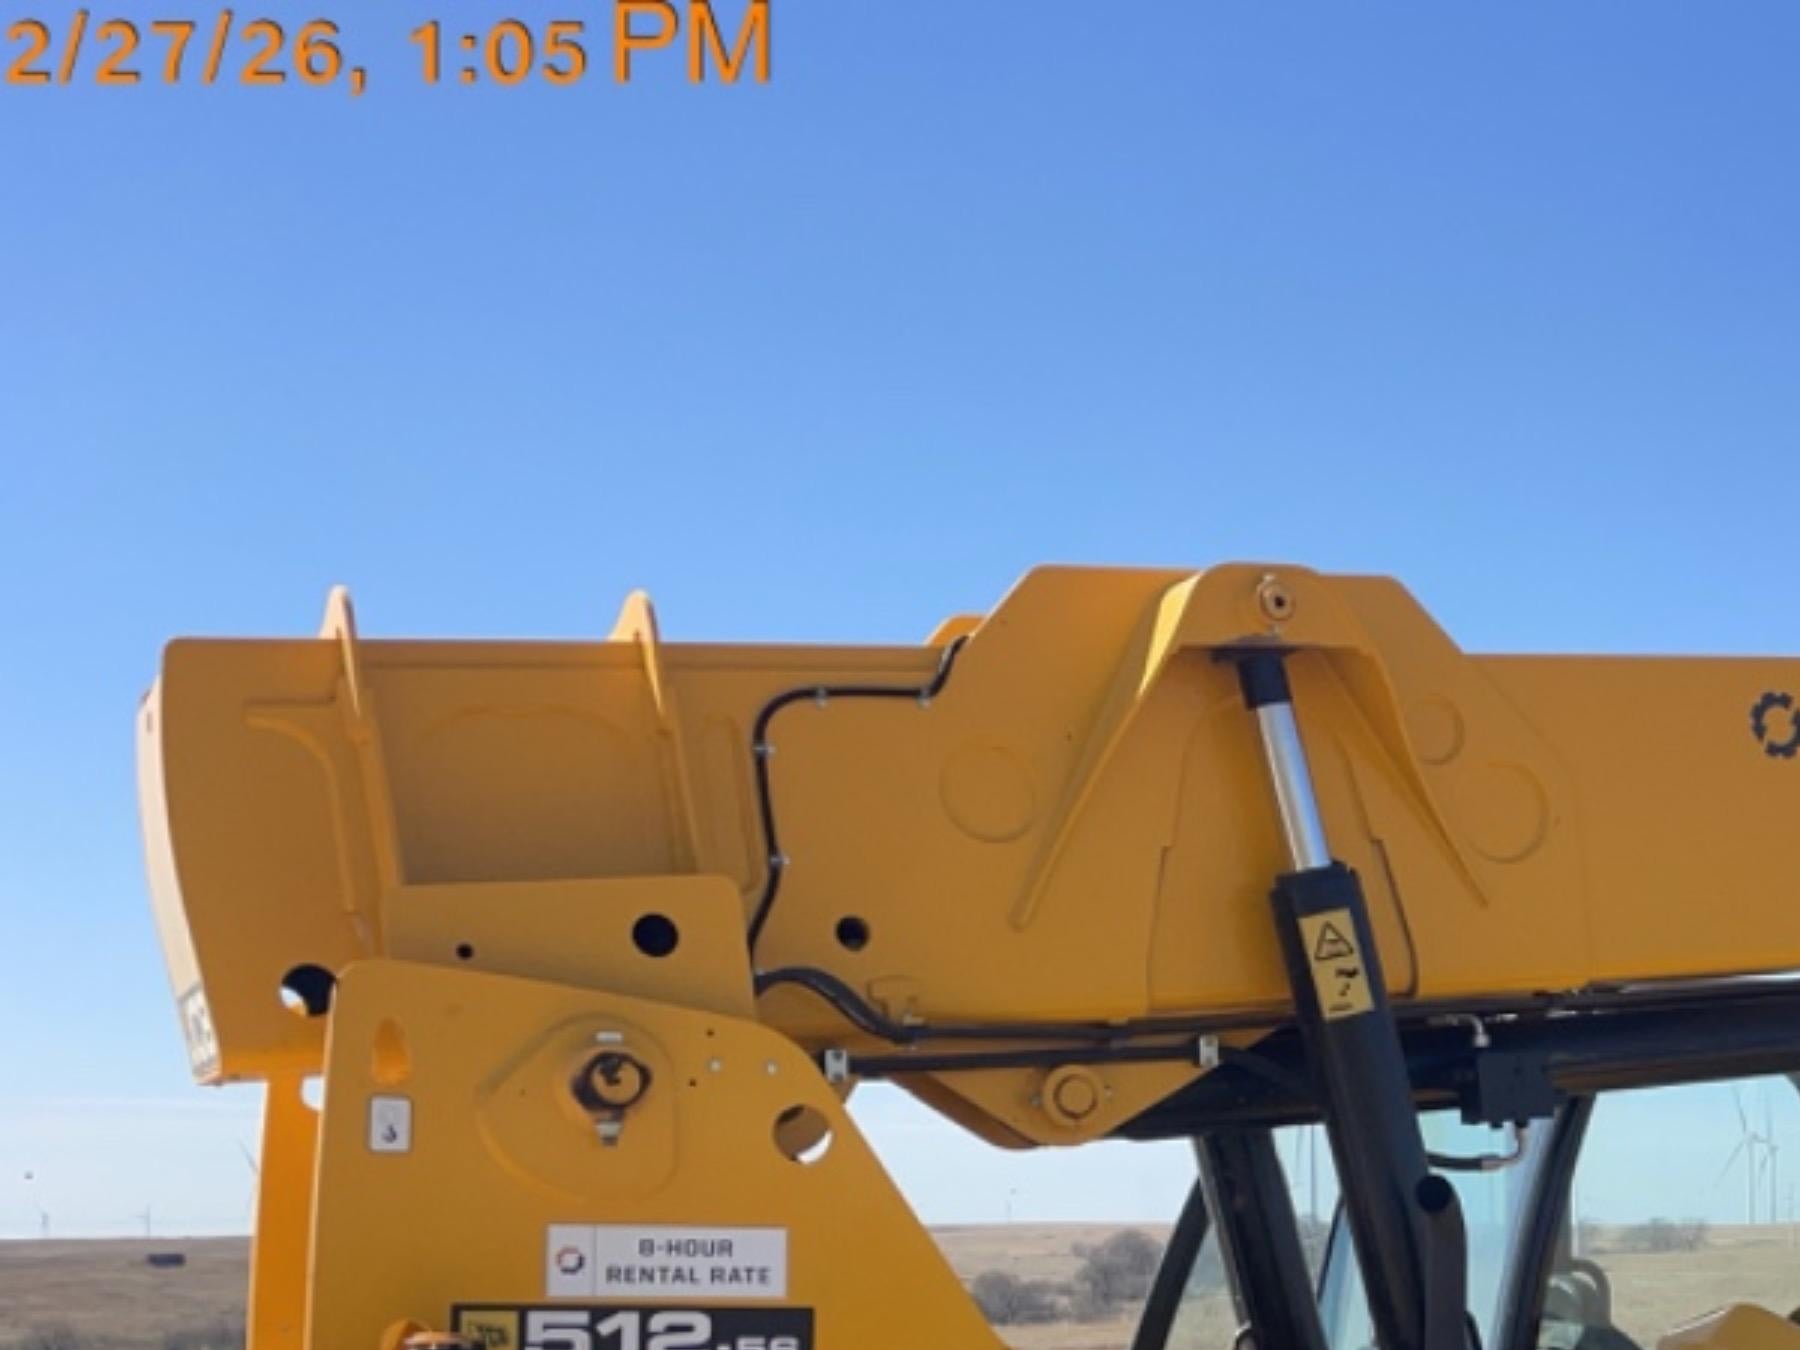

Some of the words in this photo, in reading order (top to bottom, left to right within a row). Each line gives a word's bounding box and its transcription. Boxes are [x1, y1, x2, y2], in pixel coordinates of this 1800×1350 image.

[638, 1238, 733, 1259] 8-HOUR
[605, 1265, 702, 1286] RENTAL
[710, 1265, 772, 1286] RATE
